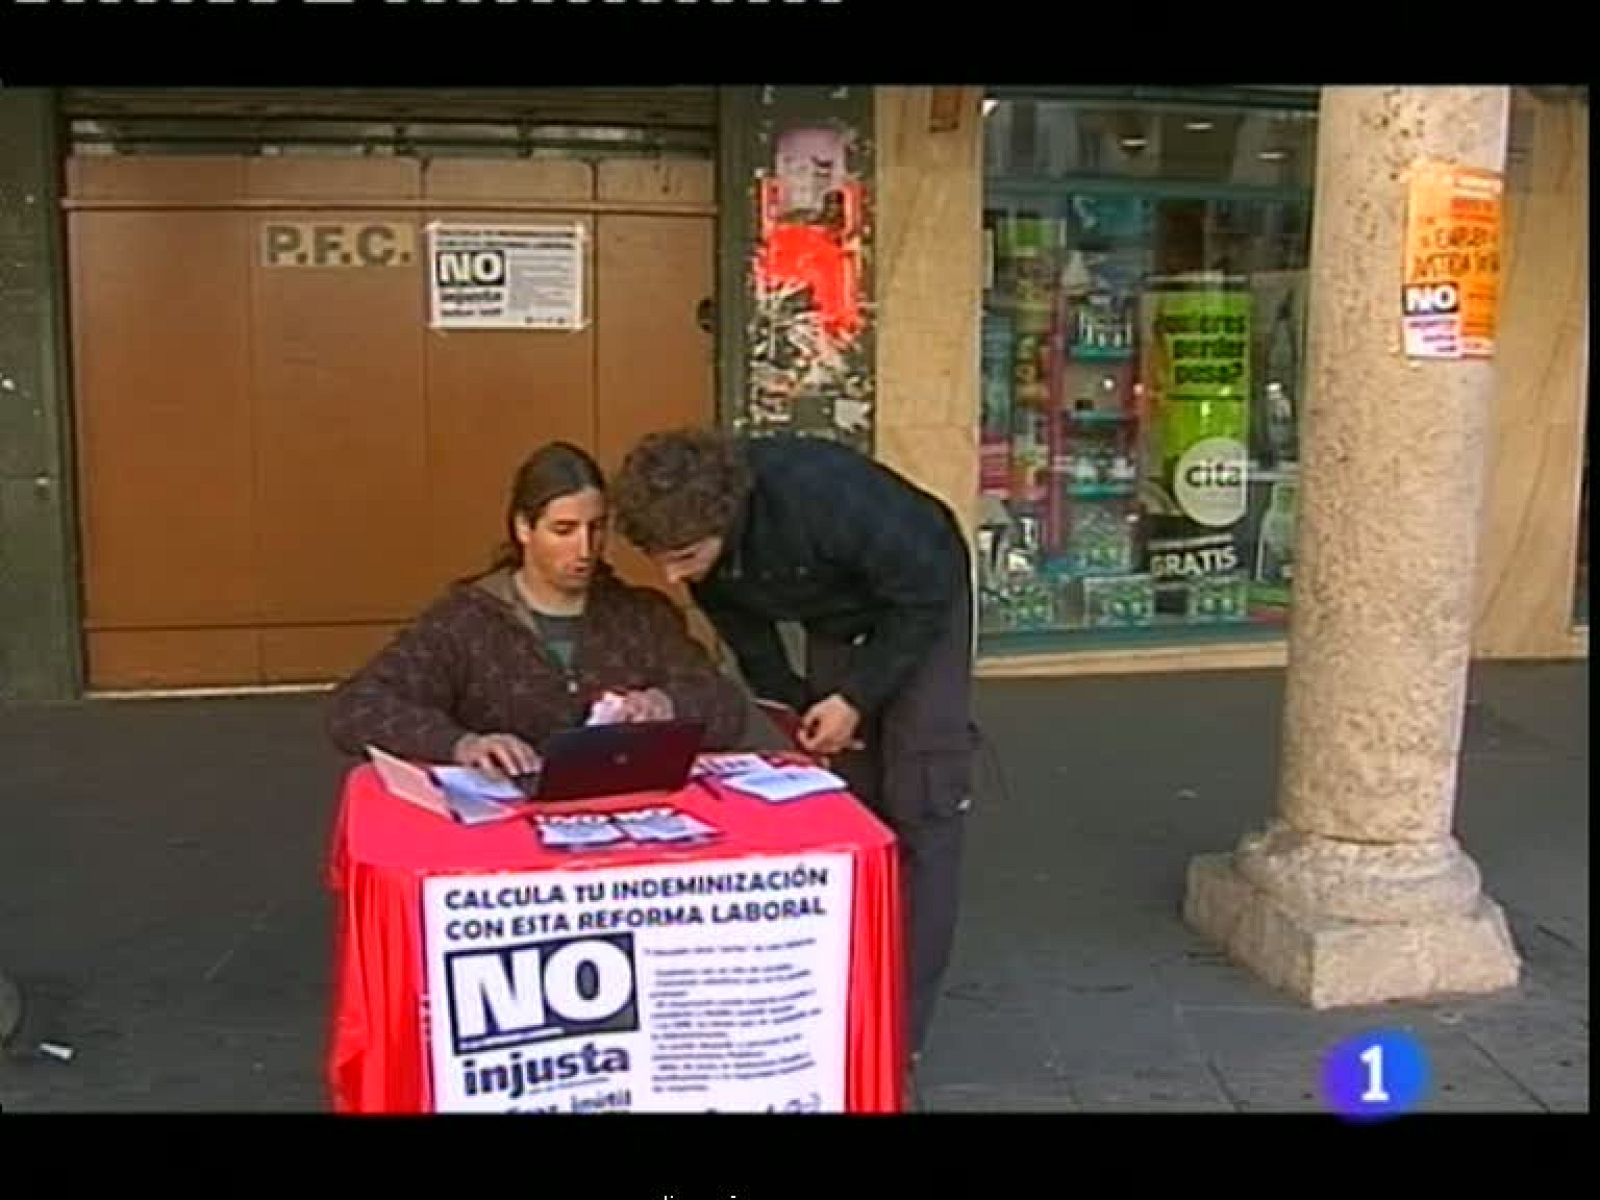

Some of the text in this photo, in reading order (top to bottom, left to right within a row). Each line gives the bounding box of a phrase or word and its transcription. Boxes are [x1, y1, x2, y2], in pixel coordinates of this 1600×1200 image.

[266, 225, 411, 266] P.F.C.
[439, 252, 503, 283] NO
[1404, 283, 1458, 311] NO
[1185, 459, 1242, 487] cita
[1151, 546, 1238, 576] GRATIS
[444, 863, 829, 910] CALCULA TU INDEMINIZACIÓN
[445, 896, 827, 941] CON ESTA REFORMA LABORAL
[450, 938, 636, 1040] NO
[462, 1042, 630, 1100] injusta
